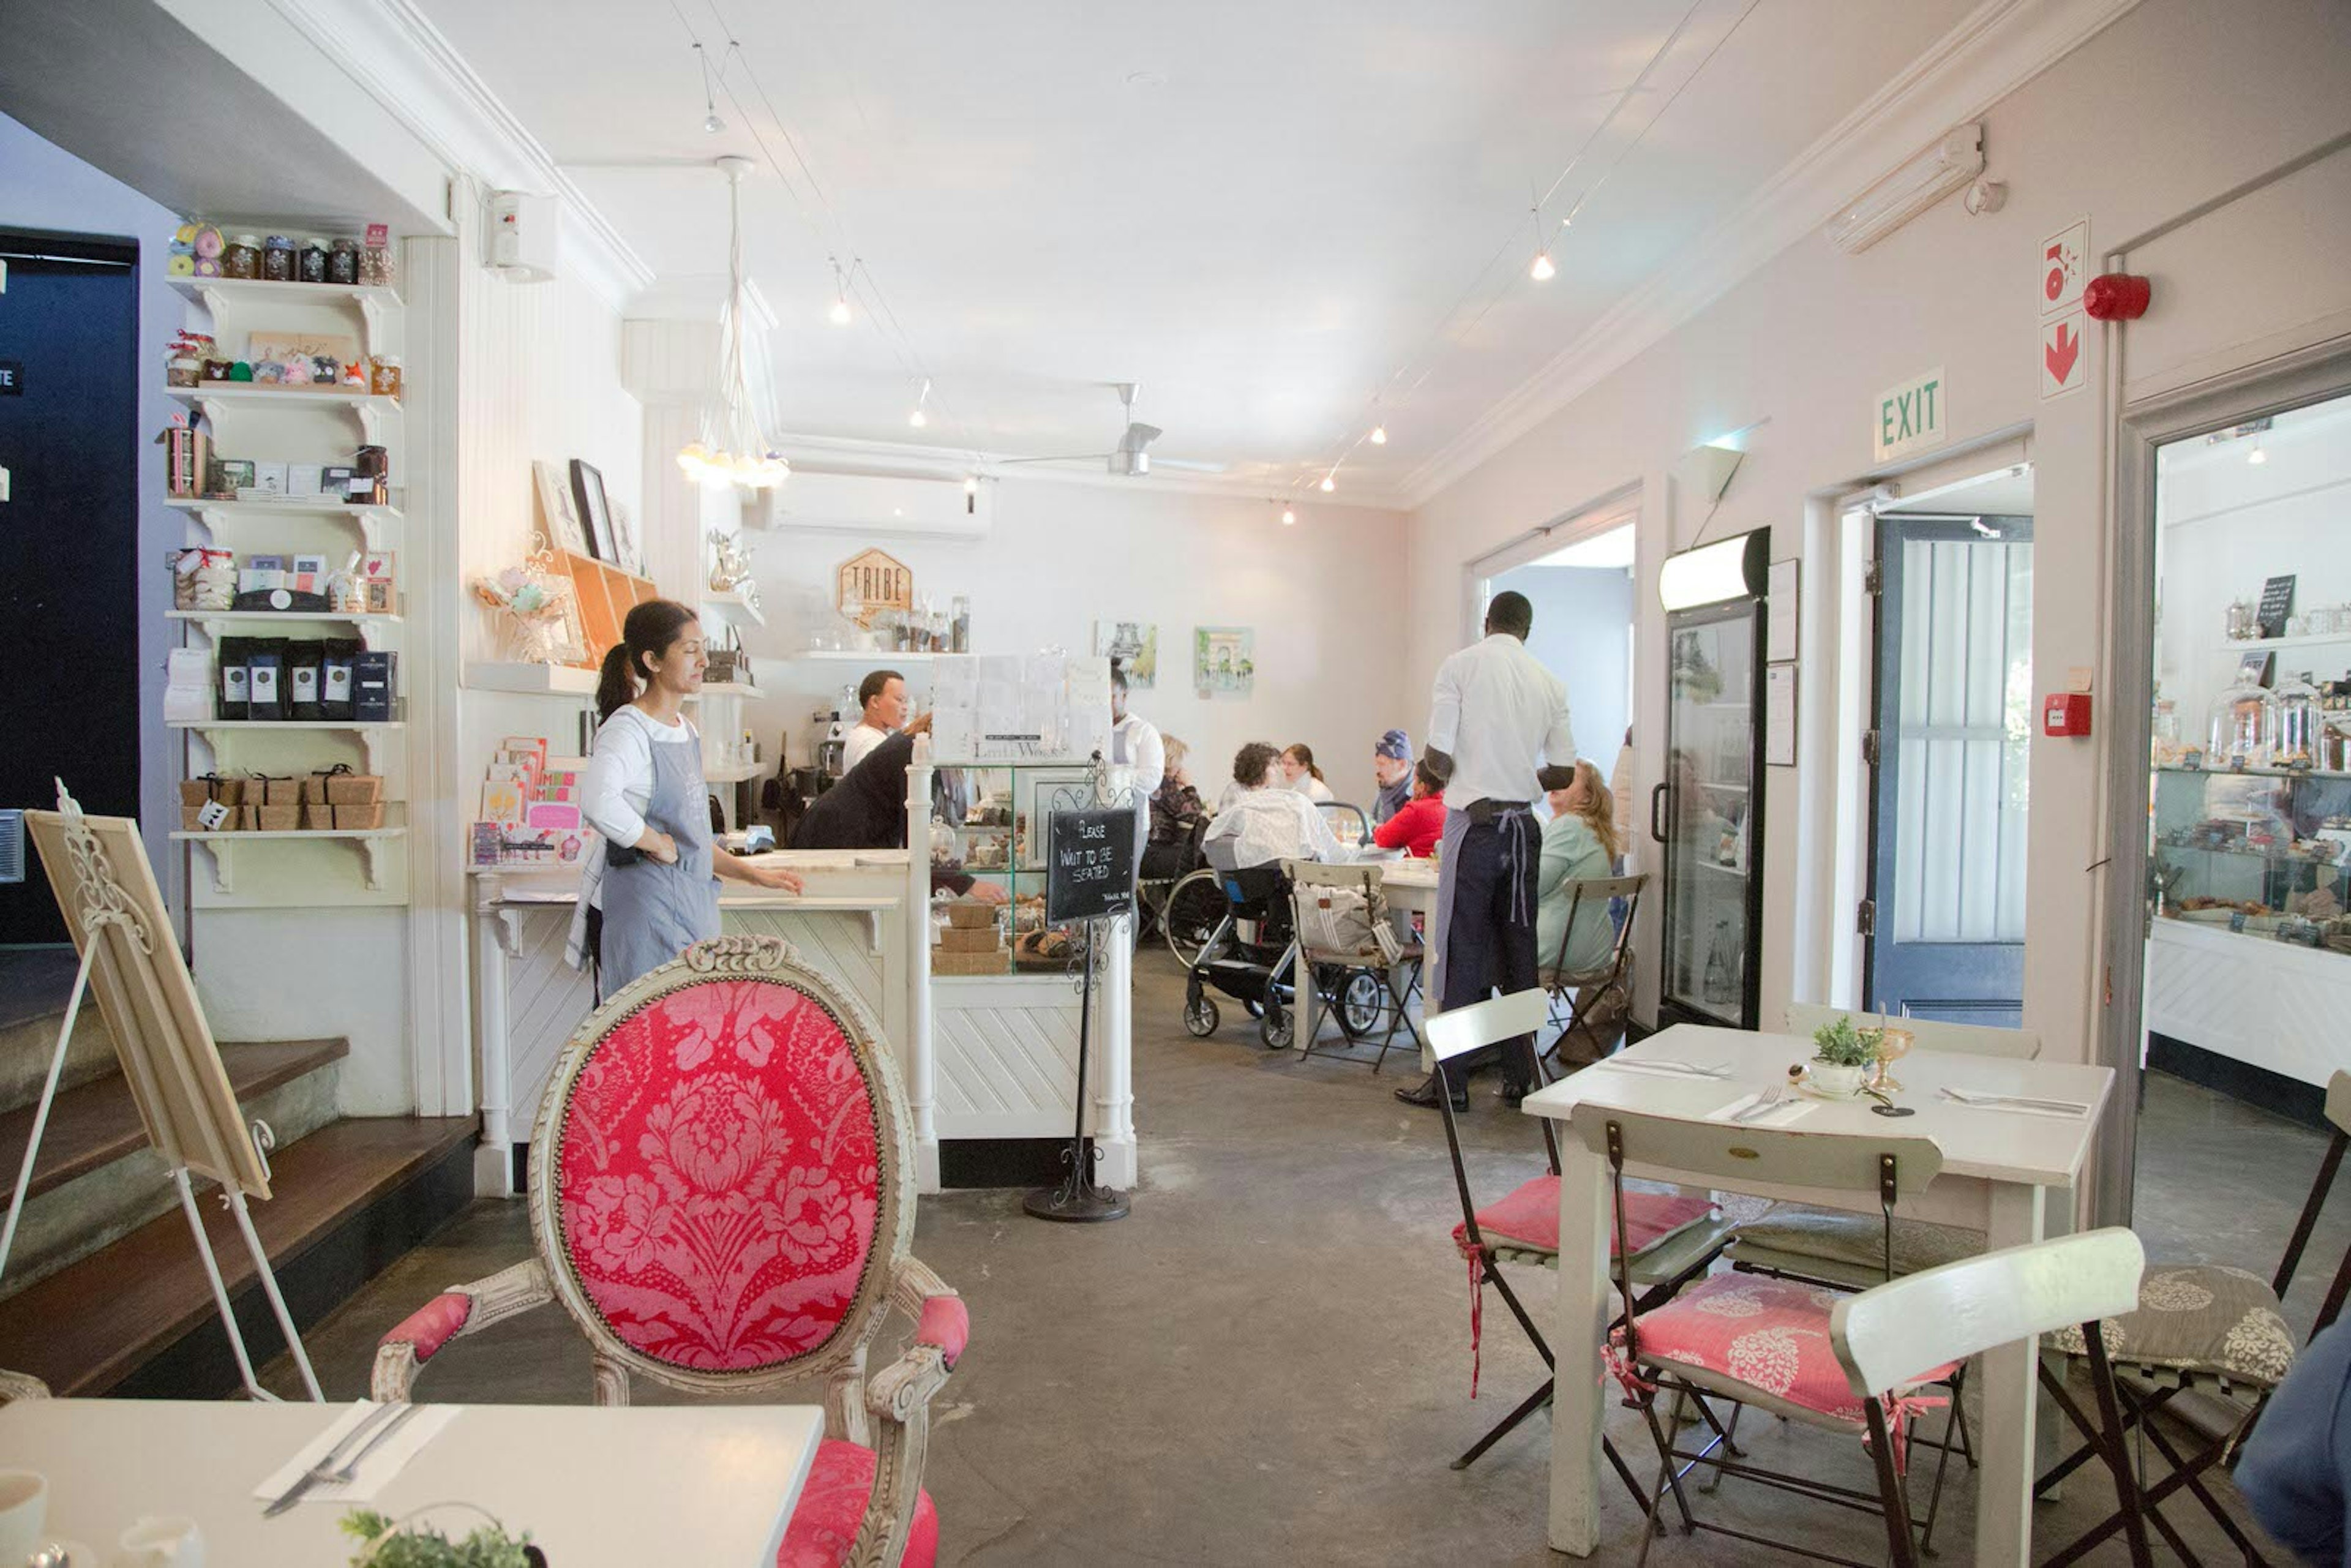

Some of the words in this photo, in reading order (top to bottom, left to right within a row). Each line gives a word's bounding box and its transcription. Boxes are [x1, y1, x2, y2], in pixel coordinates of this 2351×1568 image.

[1882, 380, 1938, 446] EXIT
[853, 566, 902, 601] TRIBE
[1079, 819, 1105, 839] PLEASE
[1085, 849, 1097, 865] TO
[1100, 846, 1113, 863] BE
[1072, 865, 1109, 883] SEATED
